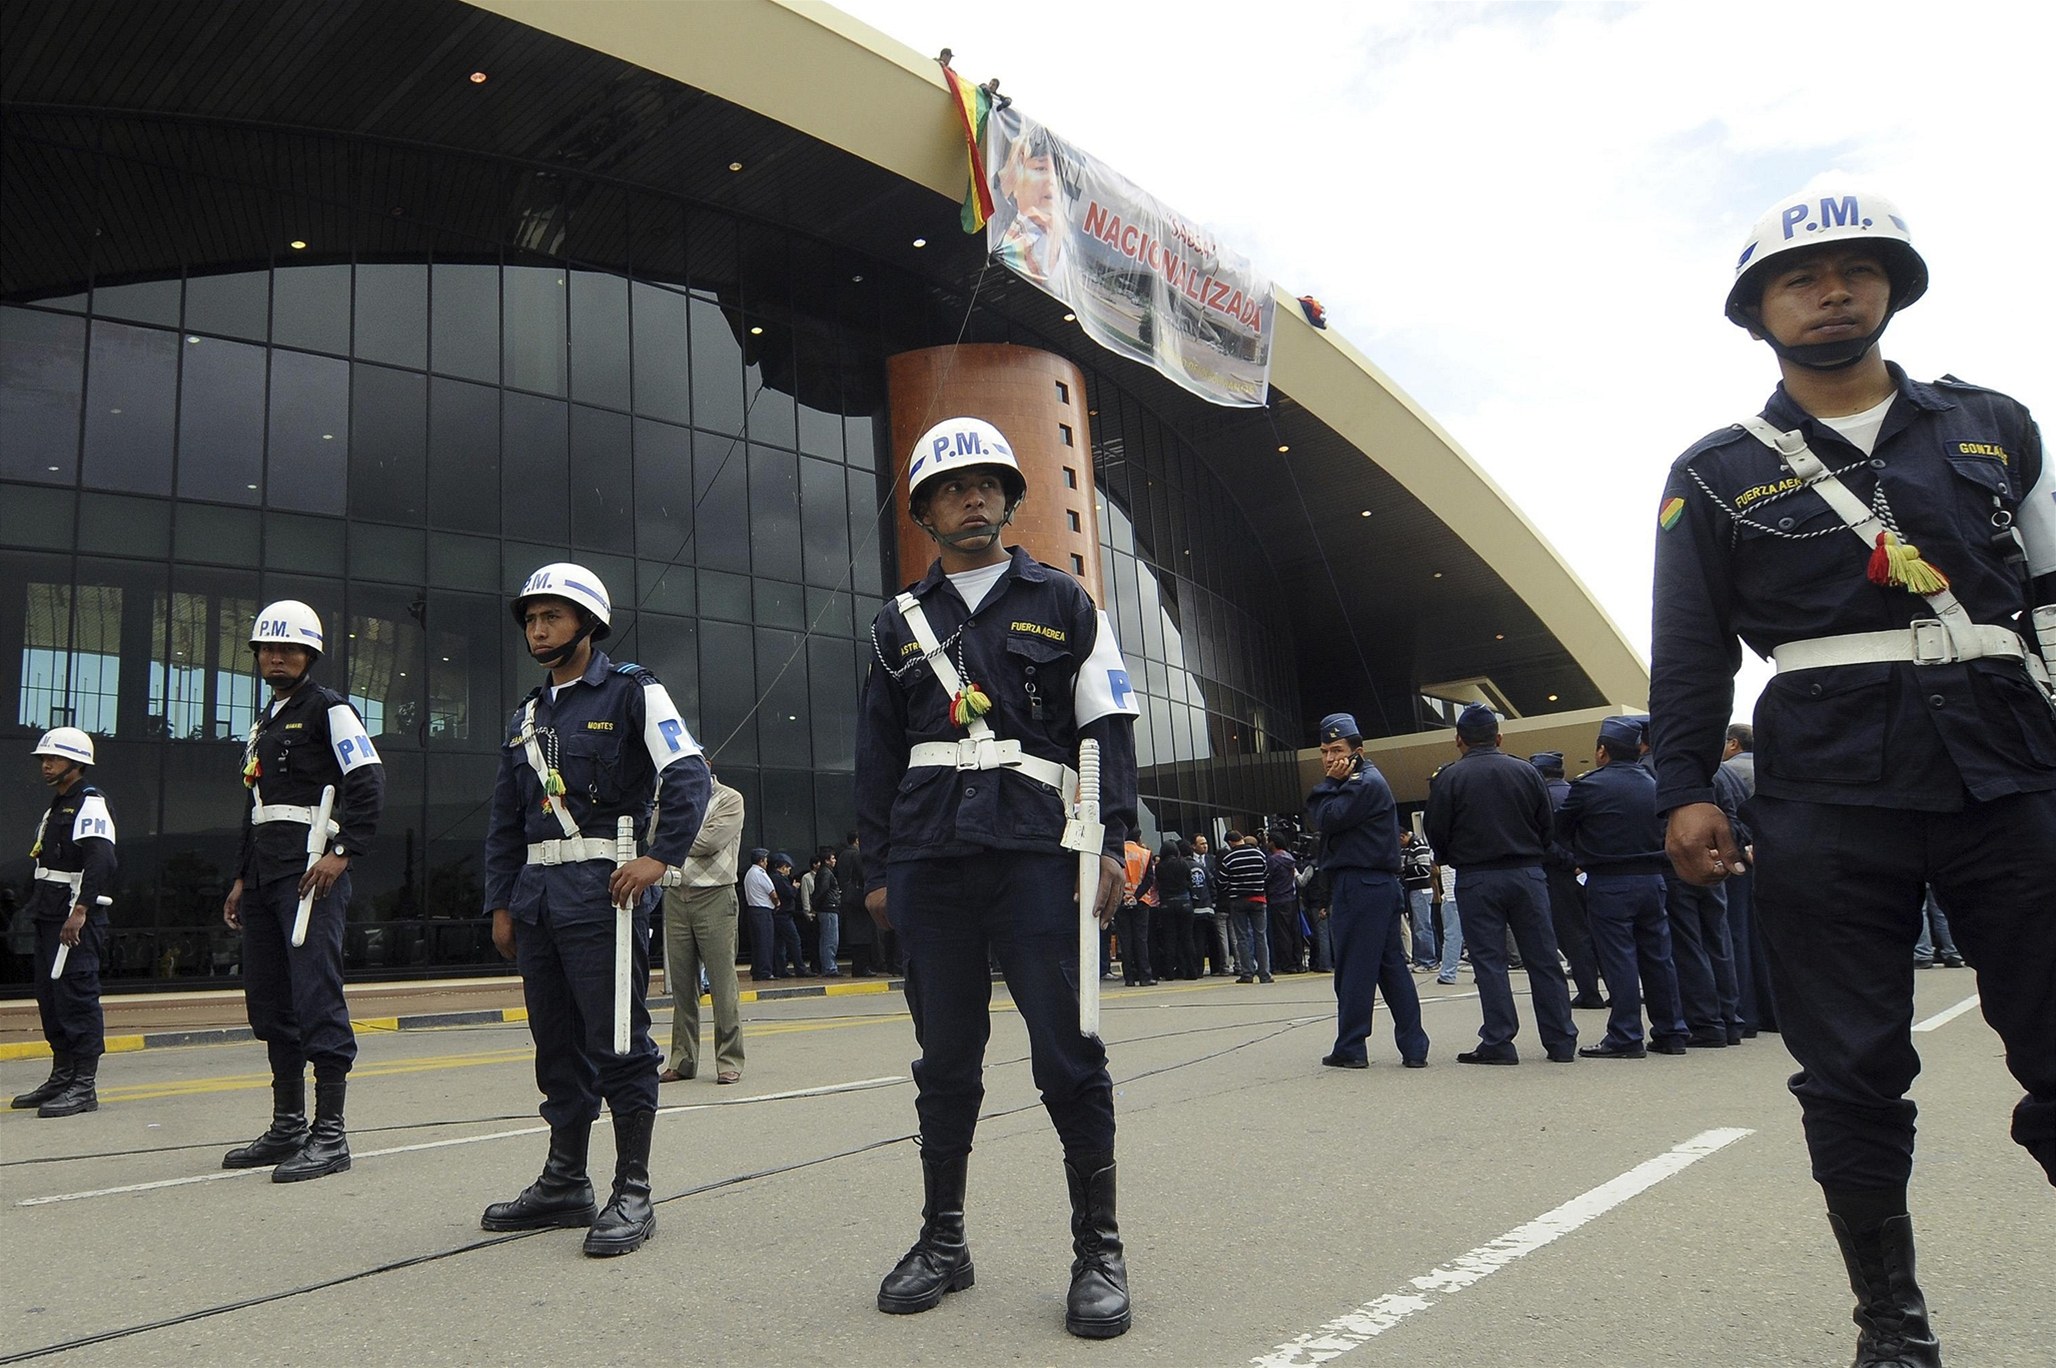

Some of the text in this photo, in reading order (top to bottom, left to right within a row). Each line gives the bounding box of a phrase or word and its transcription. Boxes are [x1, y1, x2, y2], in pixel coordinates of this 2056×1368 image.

[1782, 195, 1873, 241] P.M.
[1083, 200, 1262, 333] NACIONALIZADA
[933, 431, 989, 463] P.M.
[1734, 478, 1804, 509] FUERZA AER
[519, 572, 553, 597] P.M.
[259, 620, 290, 638] P.M.
[1010, 621, 1066, 642] FUERZA AEREA
[337, 735, 375, 766] PM
[80, 818, 106, 835] PM
